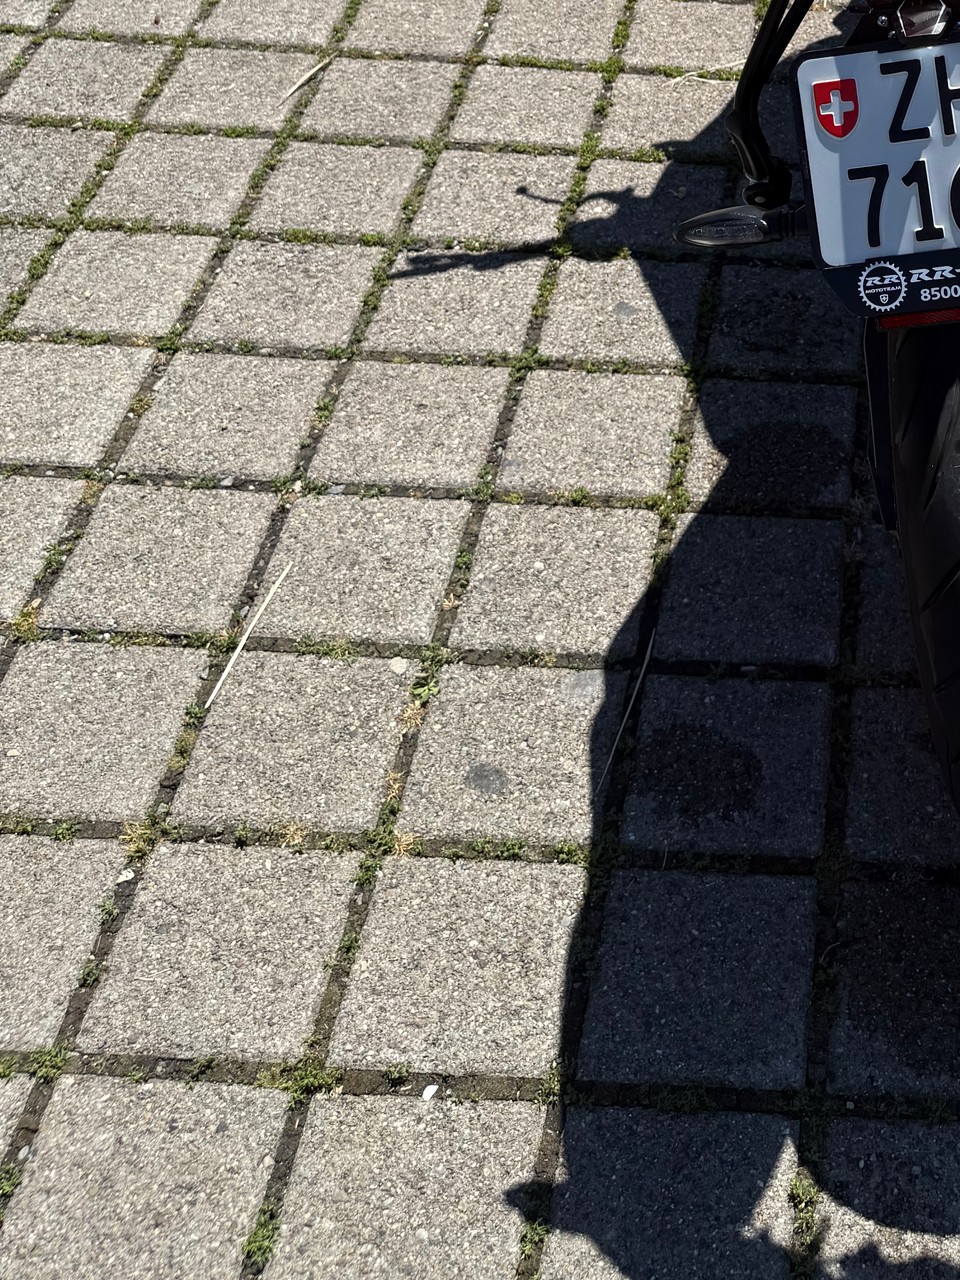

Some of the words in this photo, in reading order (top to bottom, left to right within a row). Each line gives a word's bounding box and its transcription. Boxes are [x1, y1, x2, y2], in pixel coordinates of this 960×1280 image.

[865, 274, 901, 287] RR
[864, 285, 902, 294] MOTOTEAM
[920, 284, 960, 302] 8500
